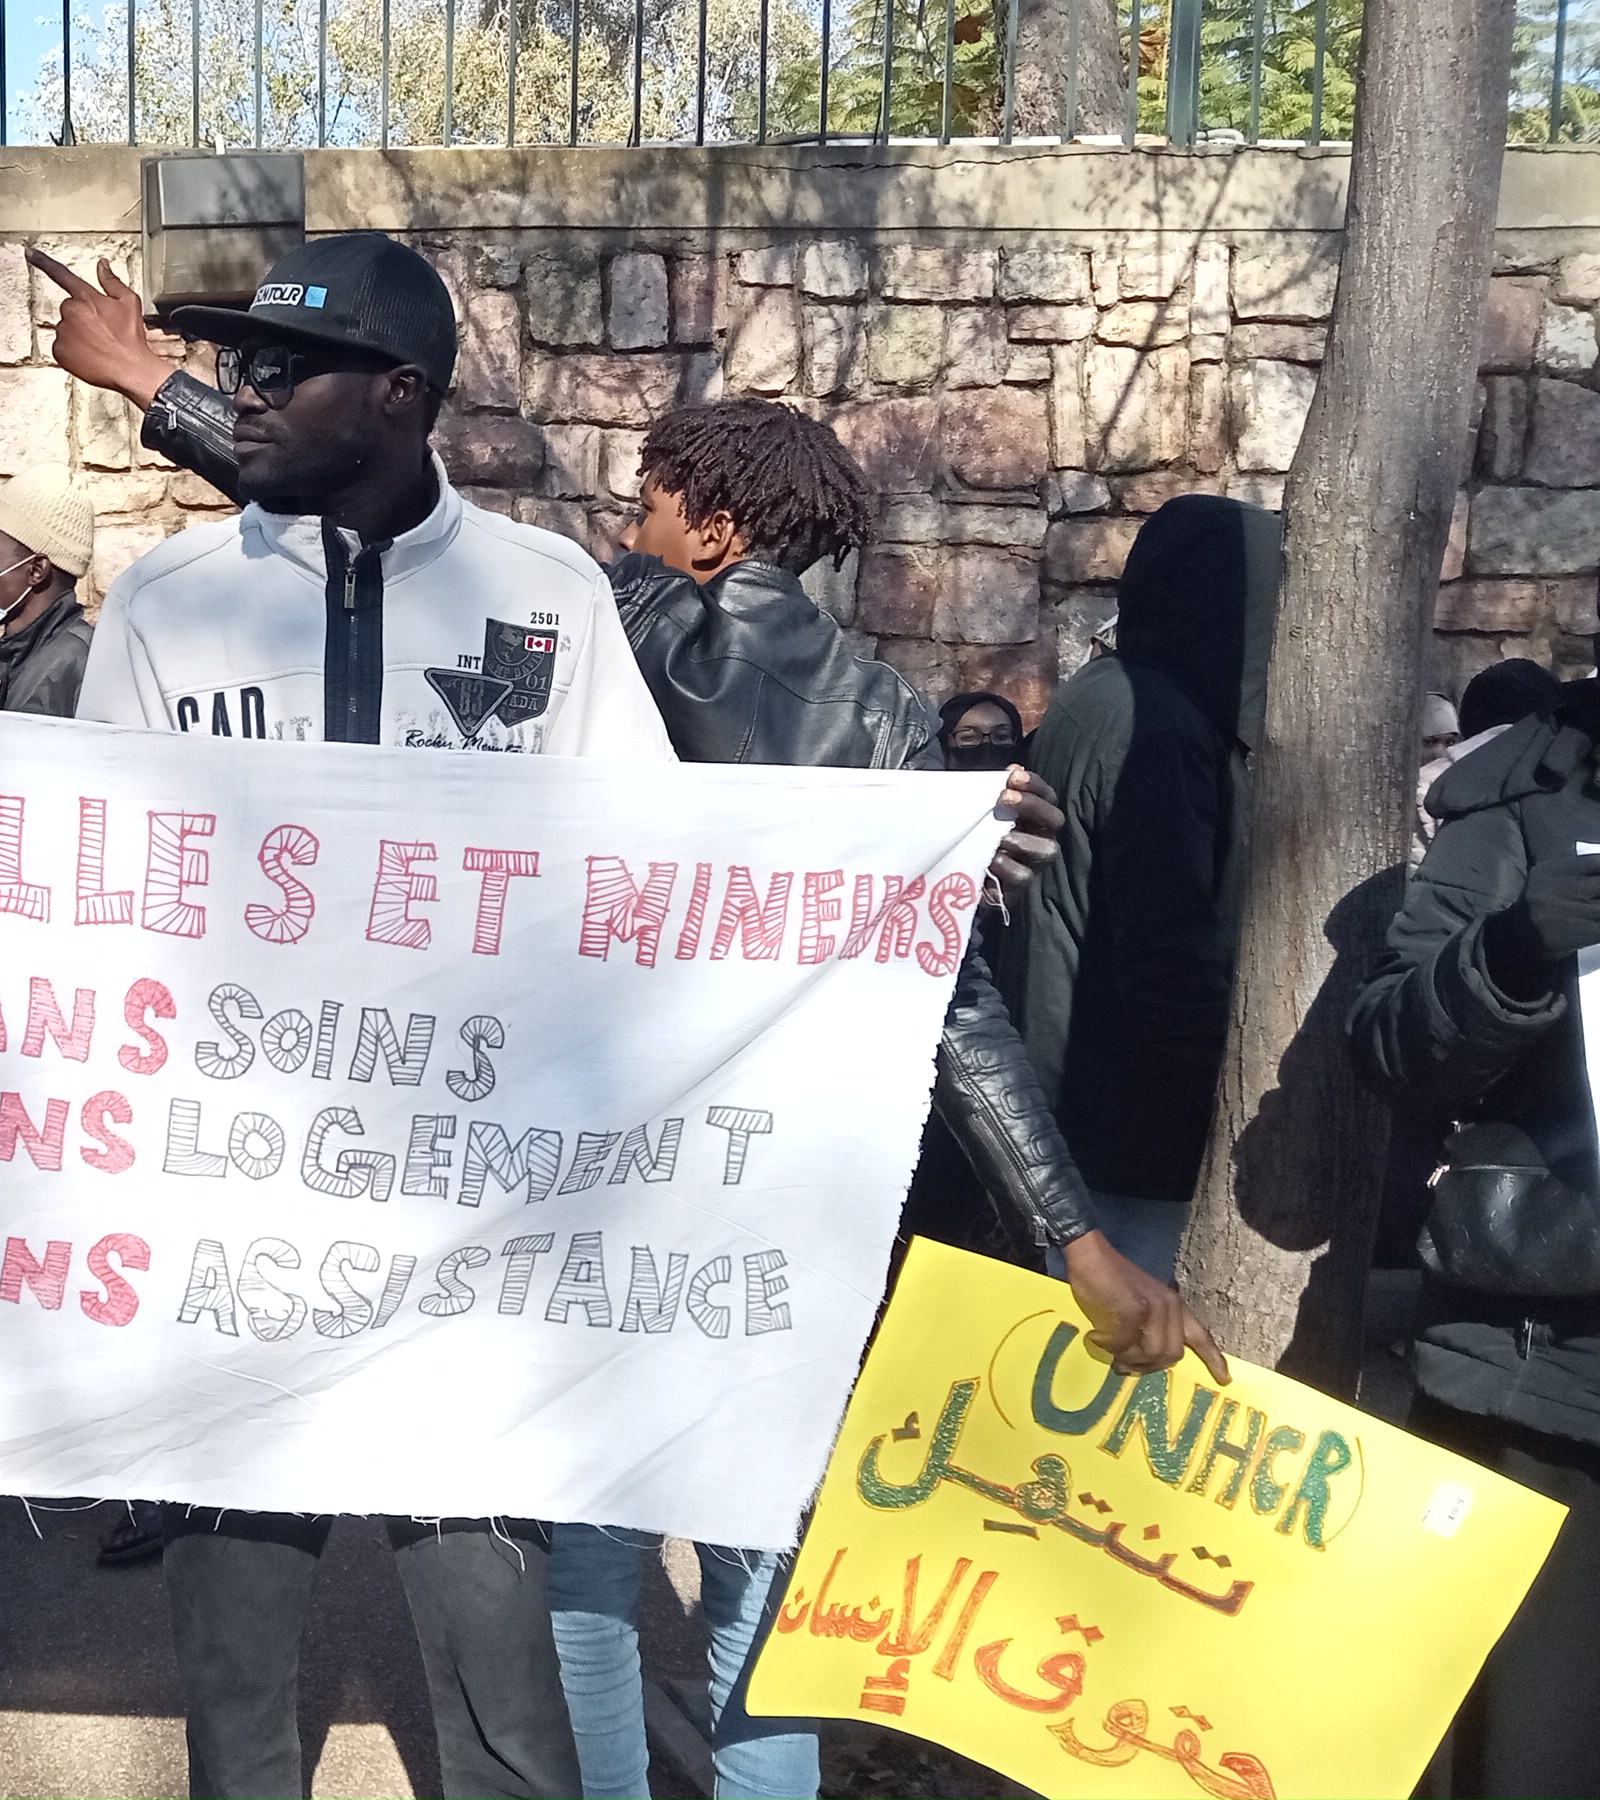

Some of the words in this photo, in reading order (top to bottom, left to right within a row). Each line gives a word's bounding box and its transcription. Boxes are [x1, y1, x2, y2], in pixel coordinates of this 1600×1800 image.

[456, 654, 482, 670] INT
[530, 612, 560, 626] 2501
[503, 694, 539, 711] ADA
[365, 838, 542, 955] ET
[196, 982, 505, 1101] SOINS
[161, 1098, 774, 1208] LOGEMENT
[176, 1230, 793, 1342] ASSISTANCE
